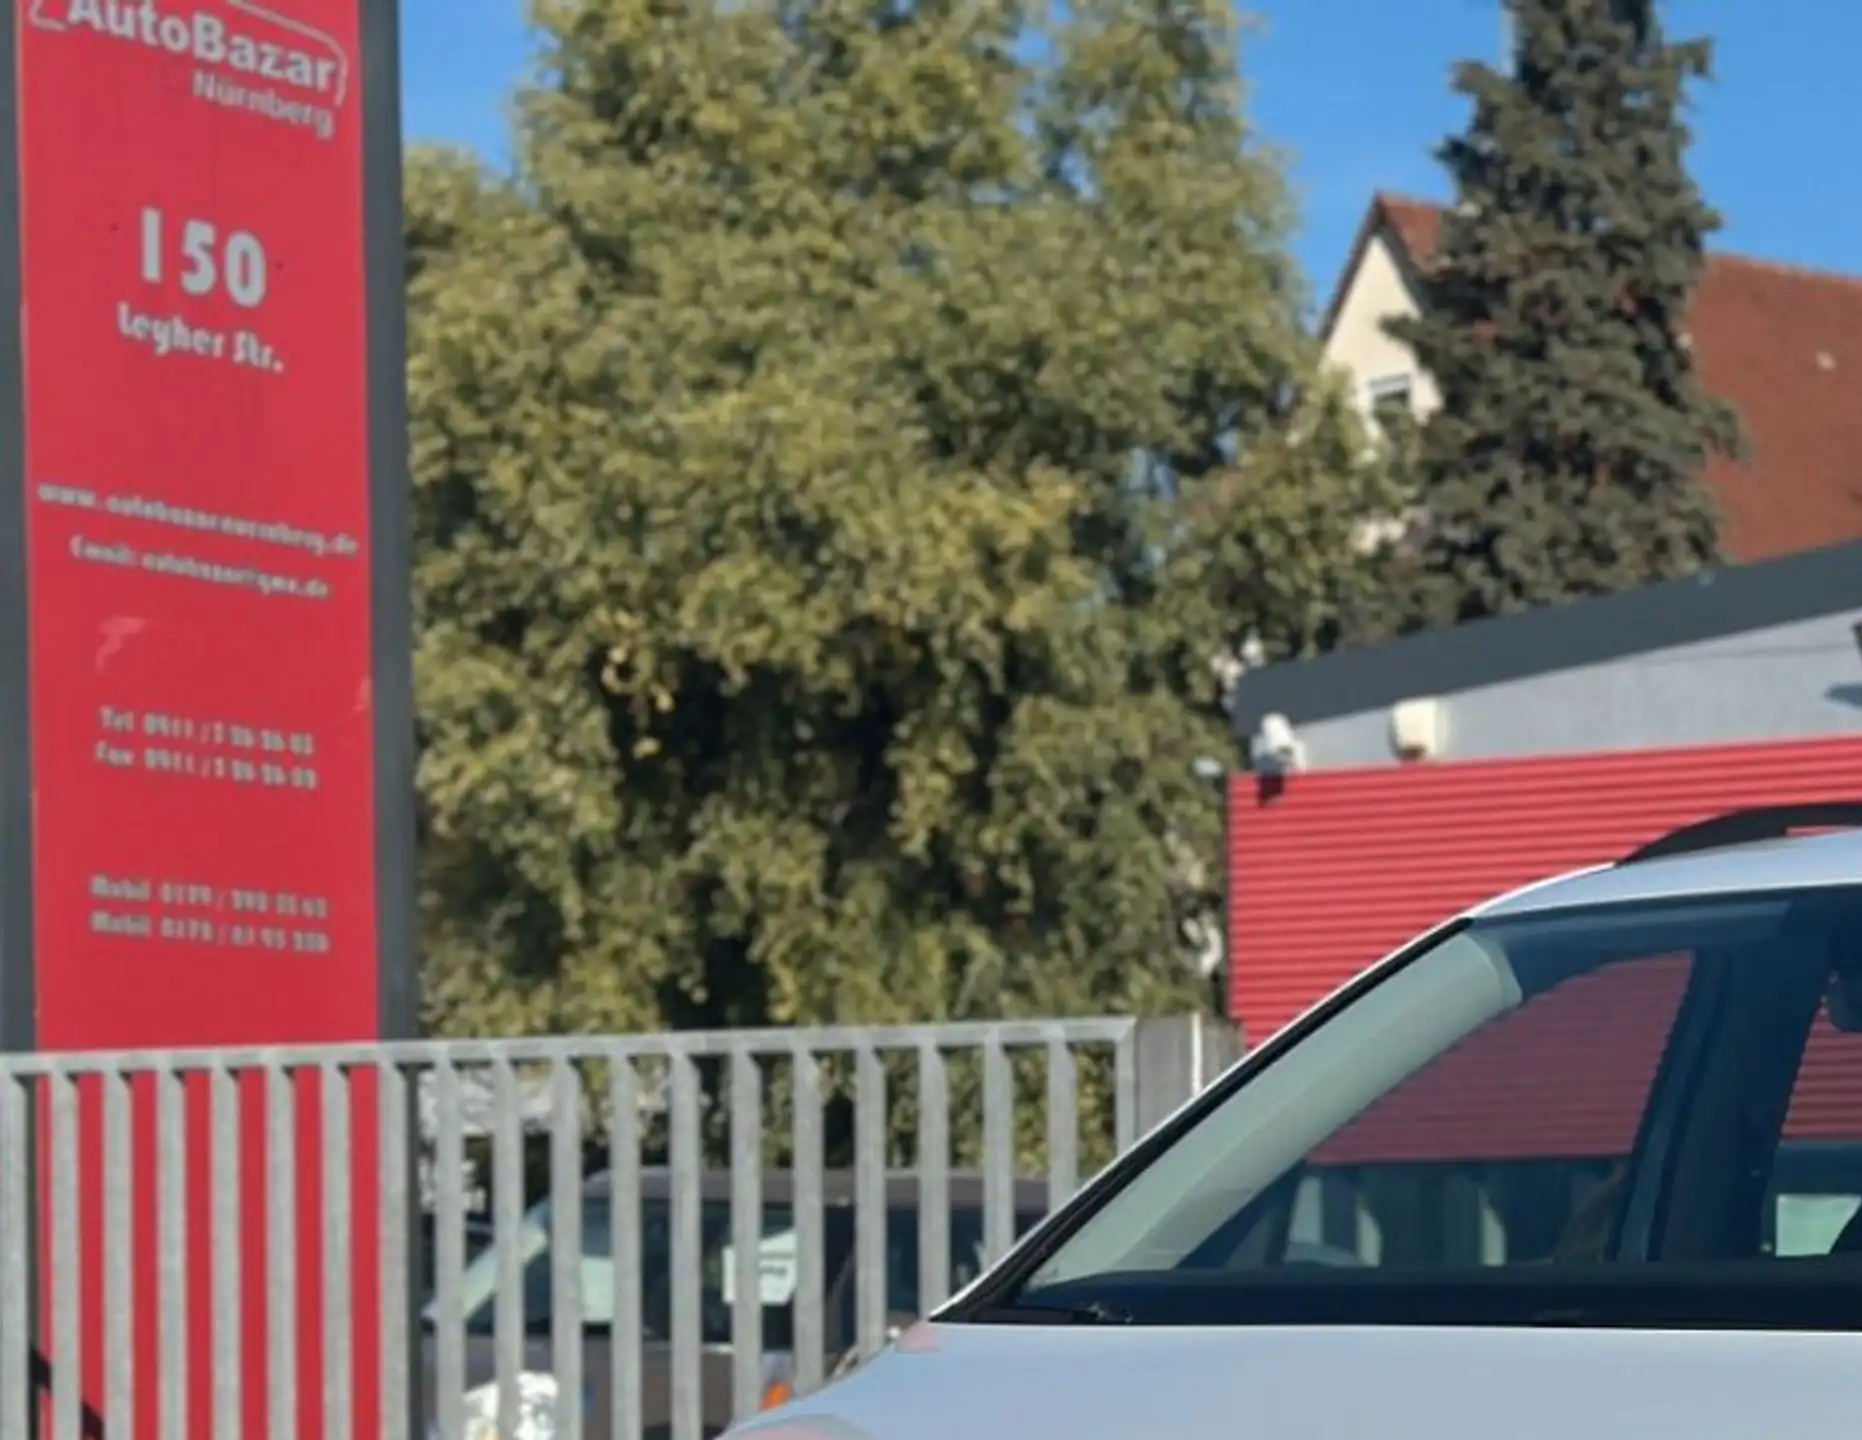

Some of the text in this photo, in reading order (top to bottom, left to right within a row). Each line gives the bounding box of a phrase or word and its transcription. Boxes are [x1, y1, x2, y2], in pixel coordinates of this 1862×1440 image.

[66, 0, 337, 91] AutoBazar
[117, 301, 285, 373] Leyher Str.
